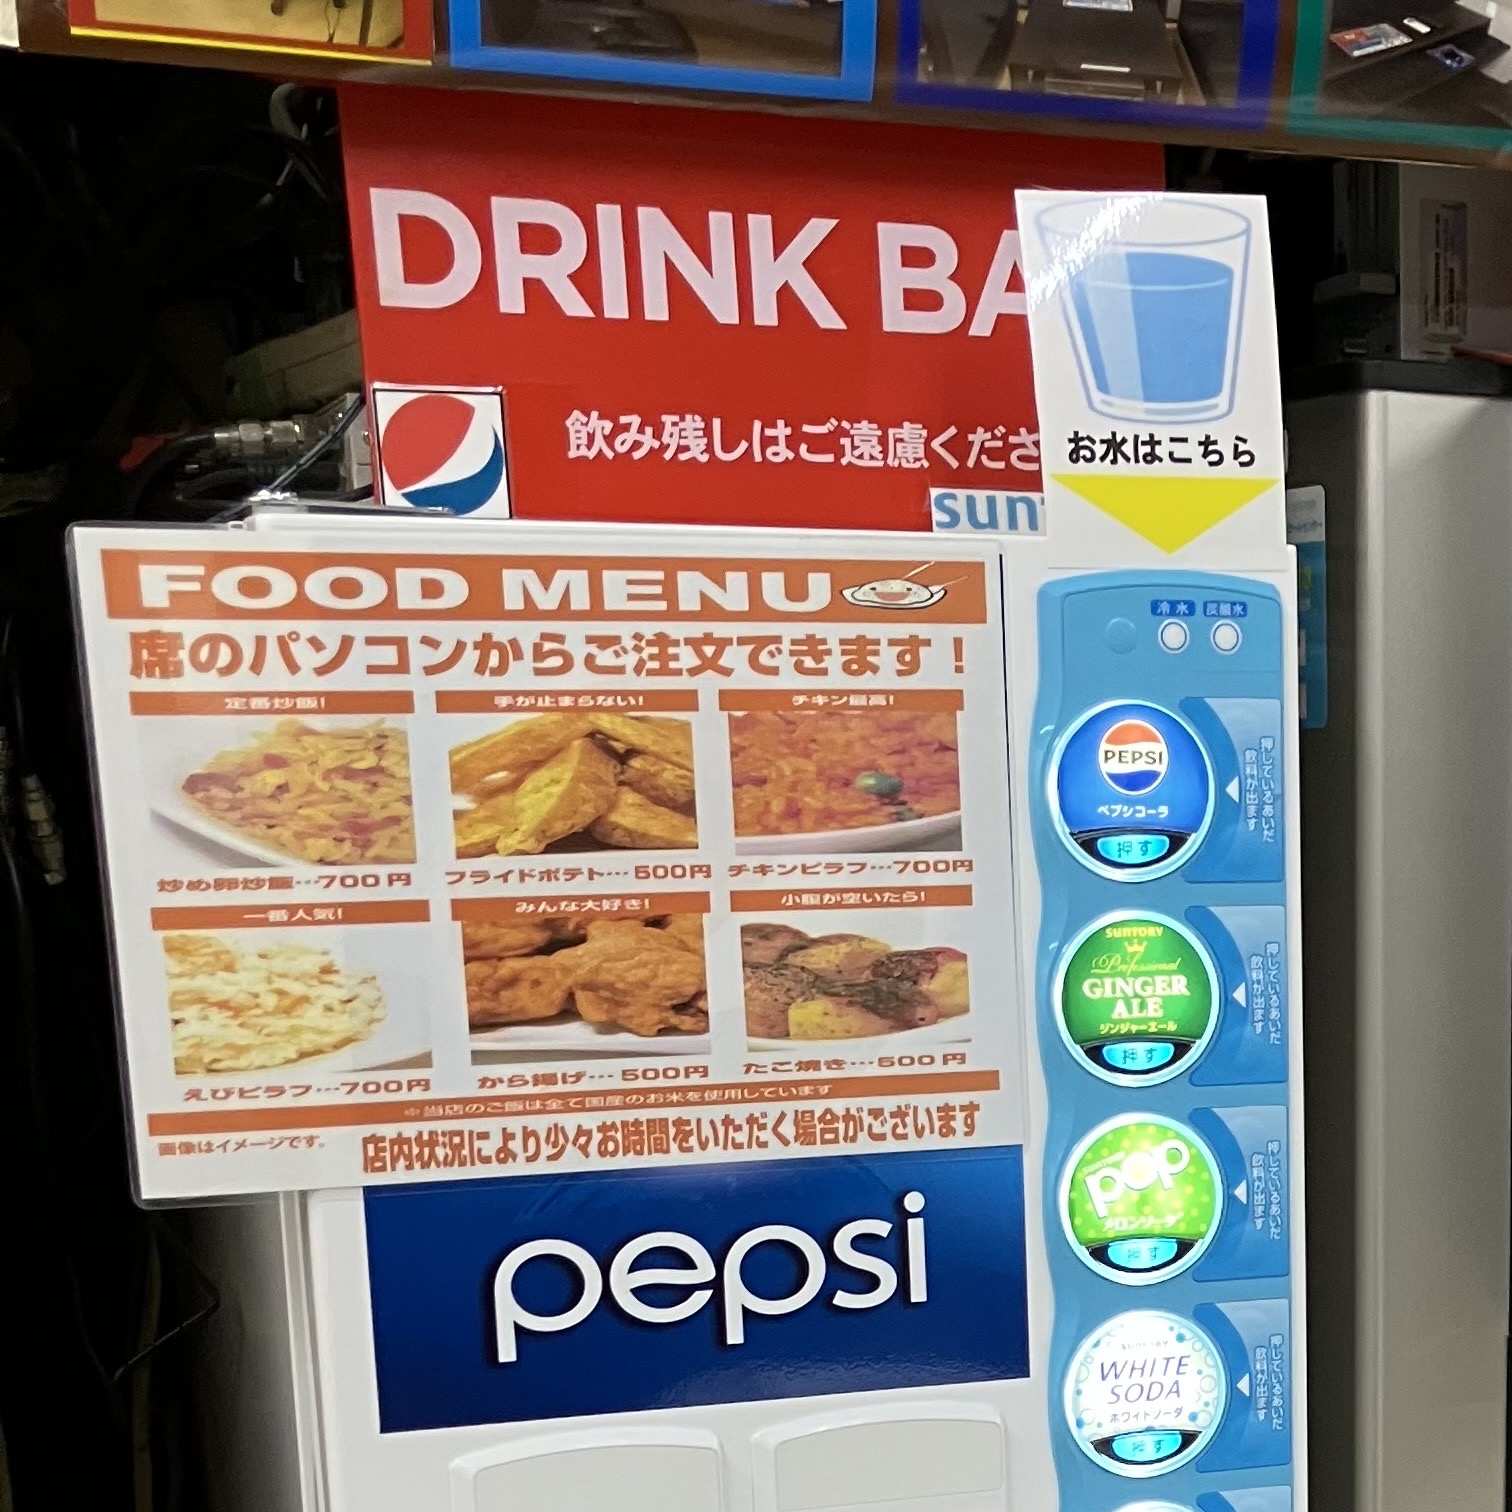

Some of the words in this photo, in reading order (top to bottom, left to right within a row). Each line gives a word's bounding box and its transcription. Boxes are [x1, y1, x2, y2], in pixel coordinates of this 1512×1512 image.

[369, 186, 847, 331] DRINK
[879, 222, 1035, 338] BA
[565, 410, 1041, 472] 飲み残しはご遠慮くださ
[1067, 430, 1257, 467] お水はこちら
[138, 563, 470, 610] FOOD
[501, 568, 832, 613] MENU
[129, 629, 965, 680] 席のパソコンからご注文できます！
[1104, 750, 1163, 765] PEPSI
[1097, 803, 1169, 819] ペプシコーラ
[1082, 974, 1191, 999] GINGER
[1111, 996, 1164, 1019] ALE
[158, 1134, 327, 1157] 画像はイメージです。
[361, 1101, 981, 1174] 店内状況により少々お時間をいただく場合がございます
[493, 1190, 928, 1364] pepsi
[1100, 1354, 1191, 1381] WHITE
[1107, 1380, 1180, 1404] SODA
[1109, 1406, 1183, 1423] ホワイトソーダ
